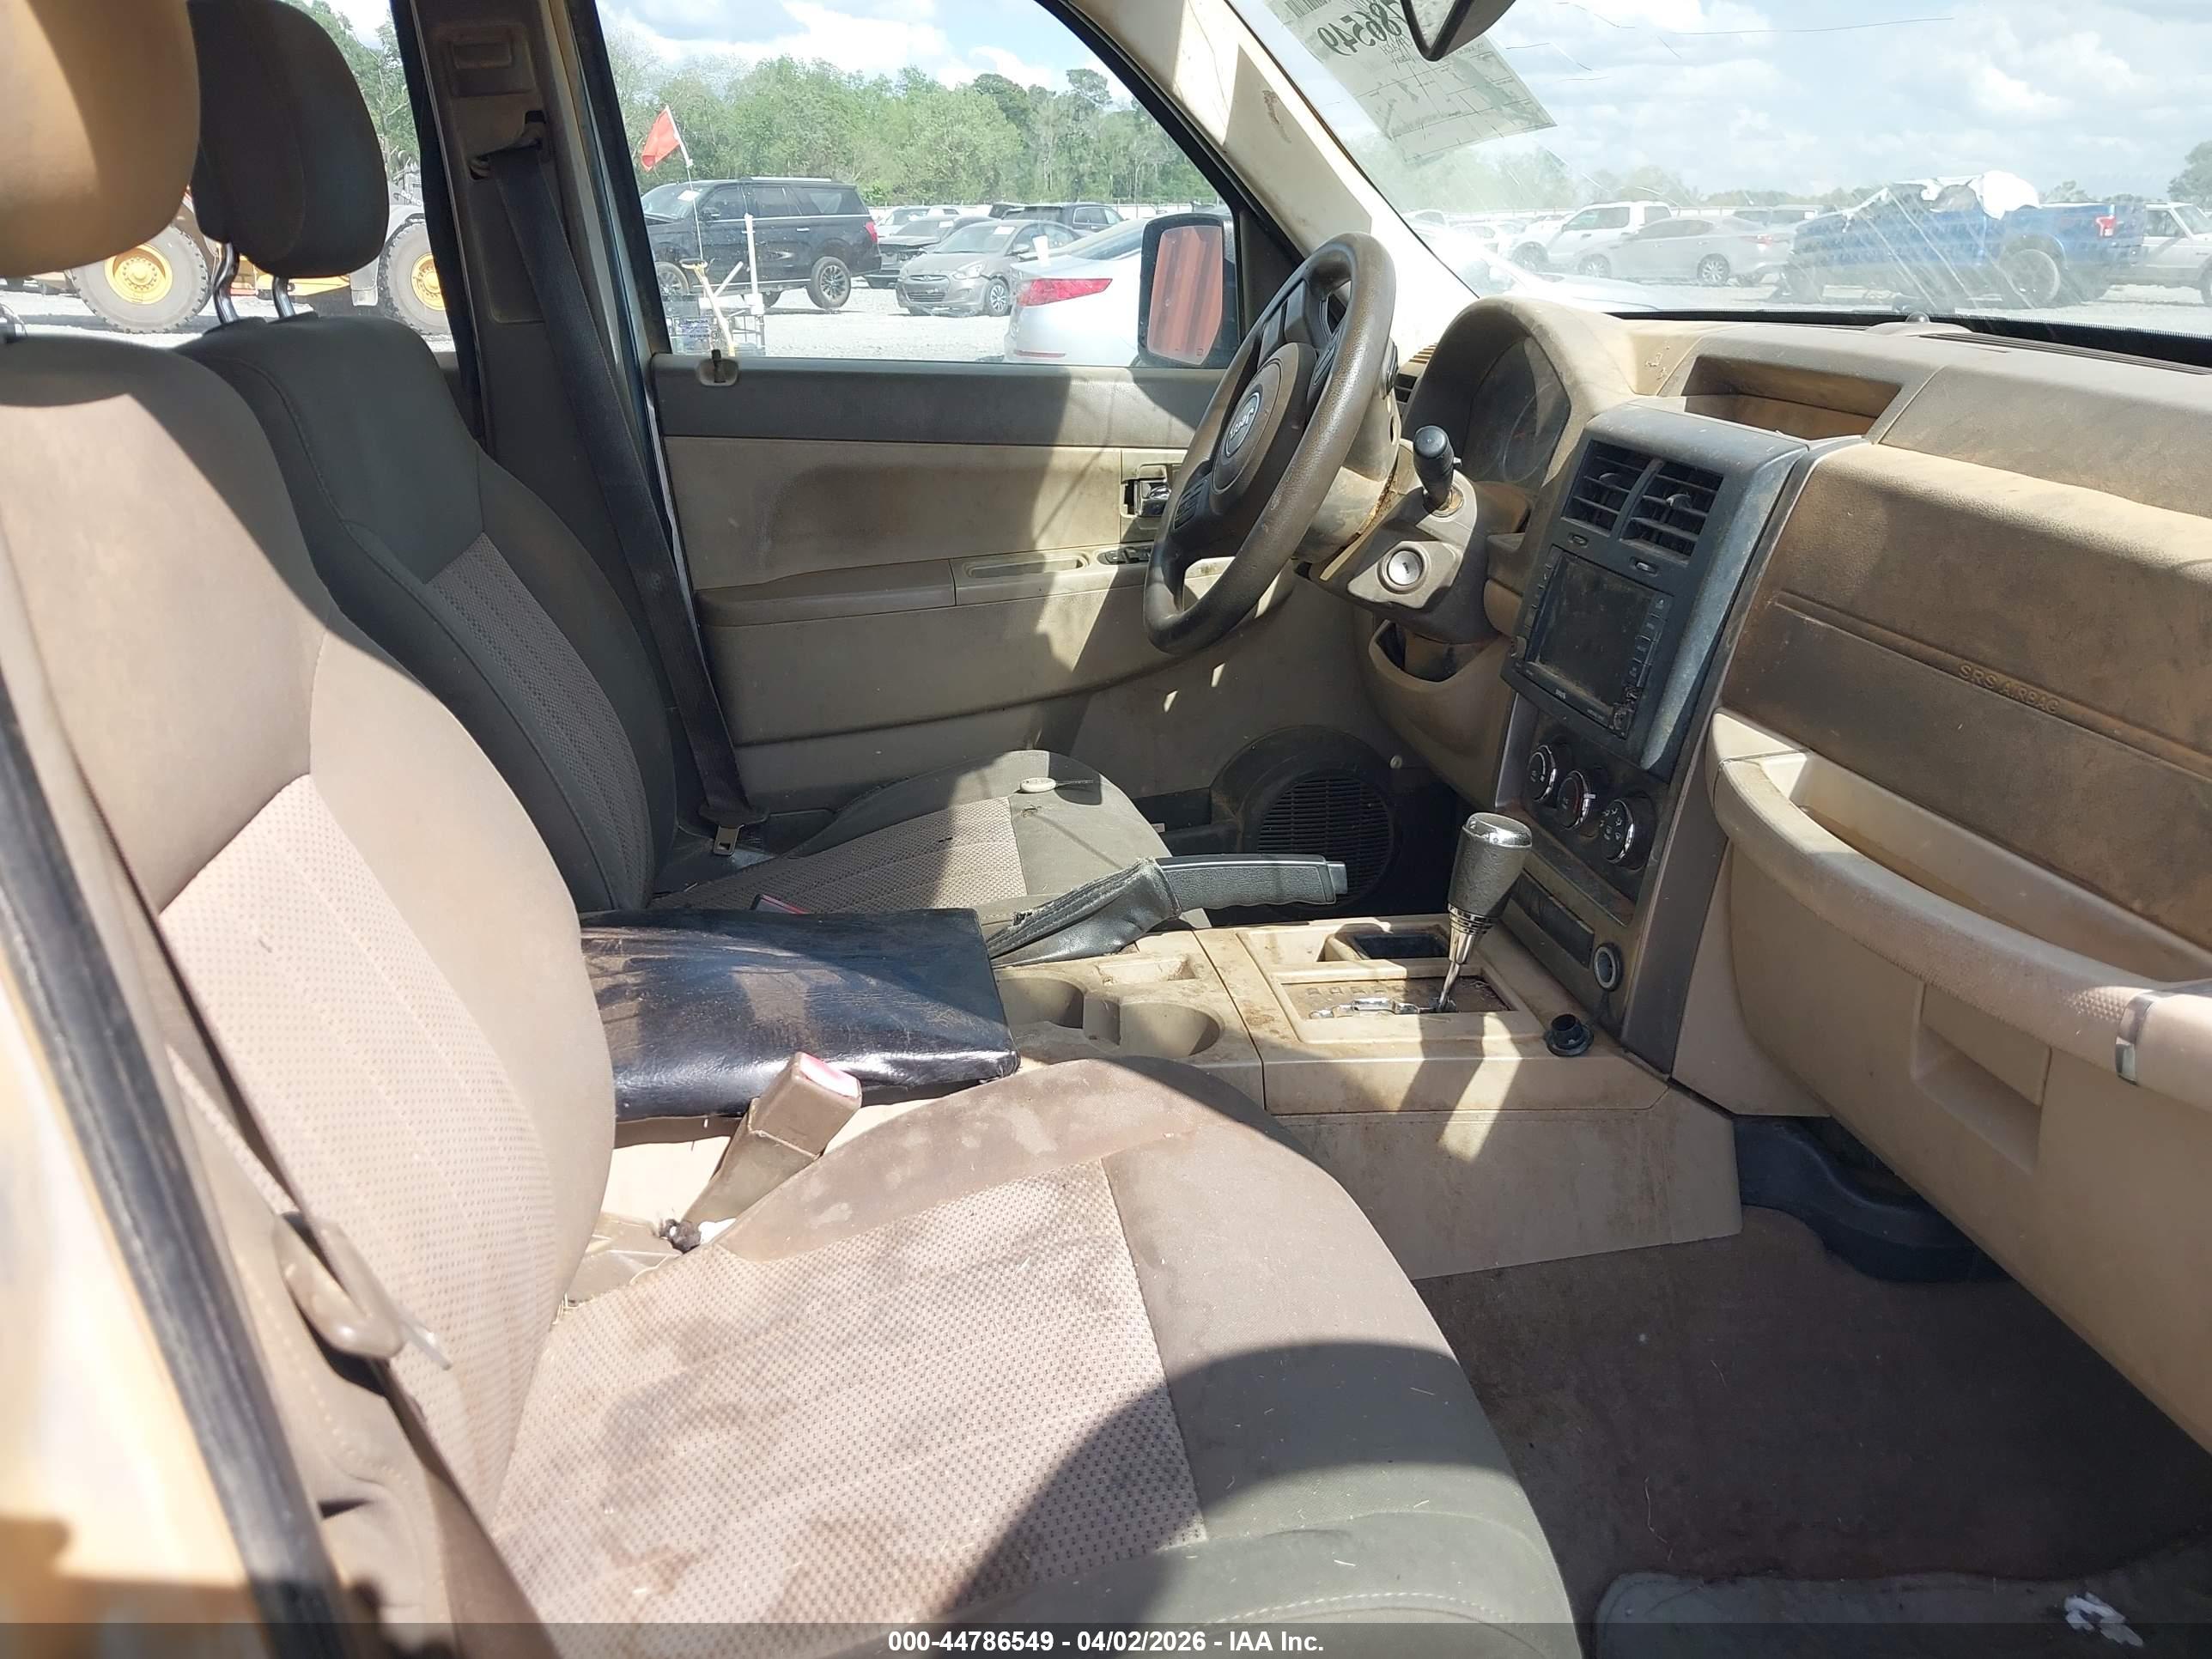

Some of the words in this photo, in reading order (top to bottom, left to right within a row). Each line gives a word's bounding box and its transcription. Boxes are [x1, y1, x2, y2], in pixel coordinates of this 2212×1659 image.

[1230, 407, 1255, 440] Jeep
[1958, 664, 1997, 689] SRS
[1999, 680, 2060, 714] AIRBAG
